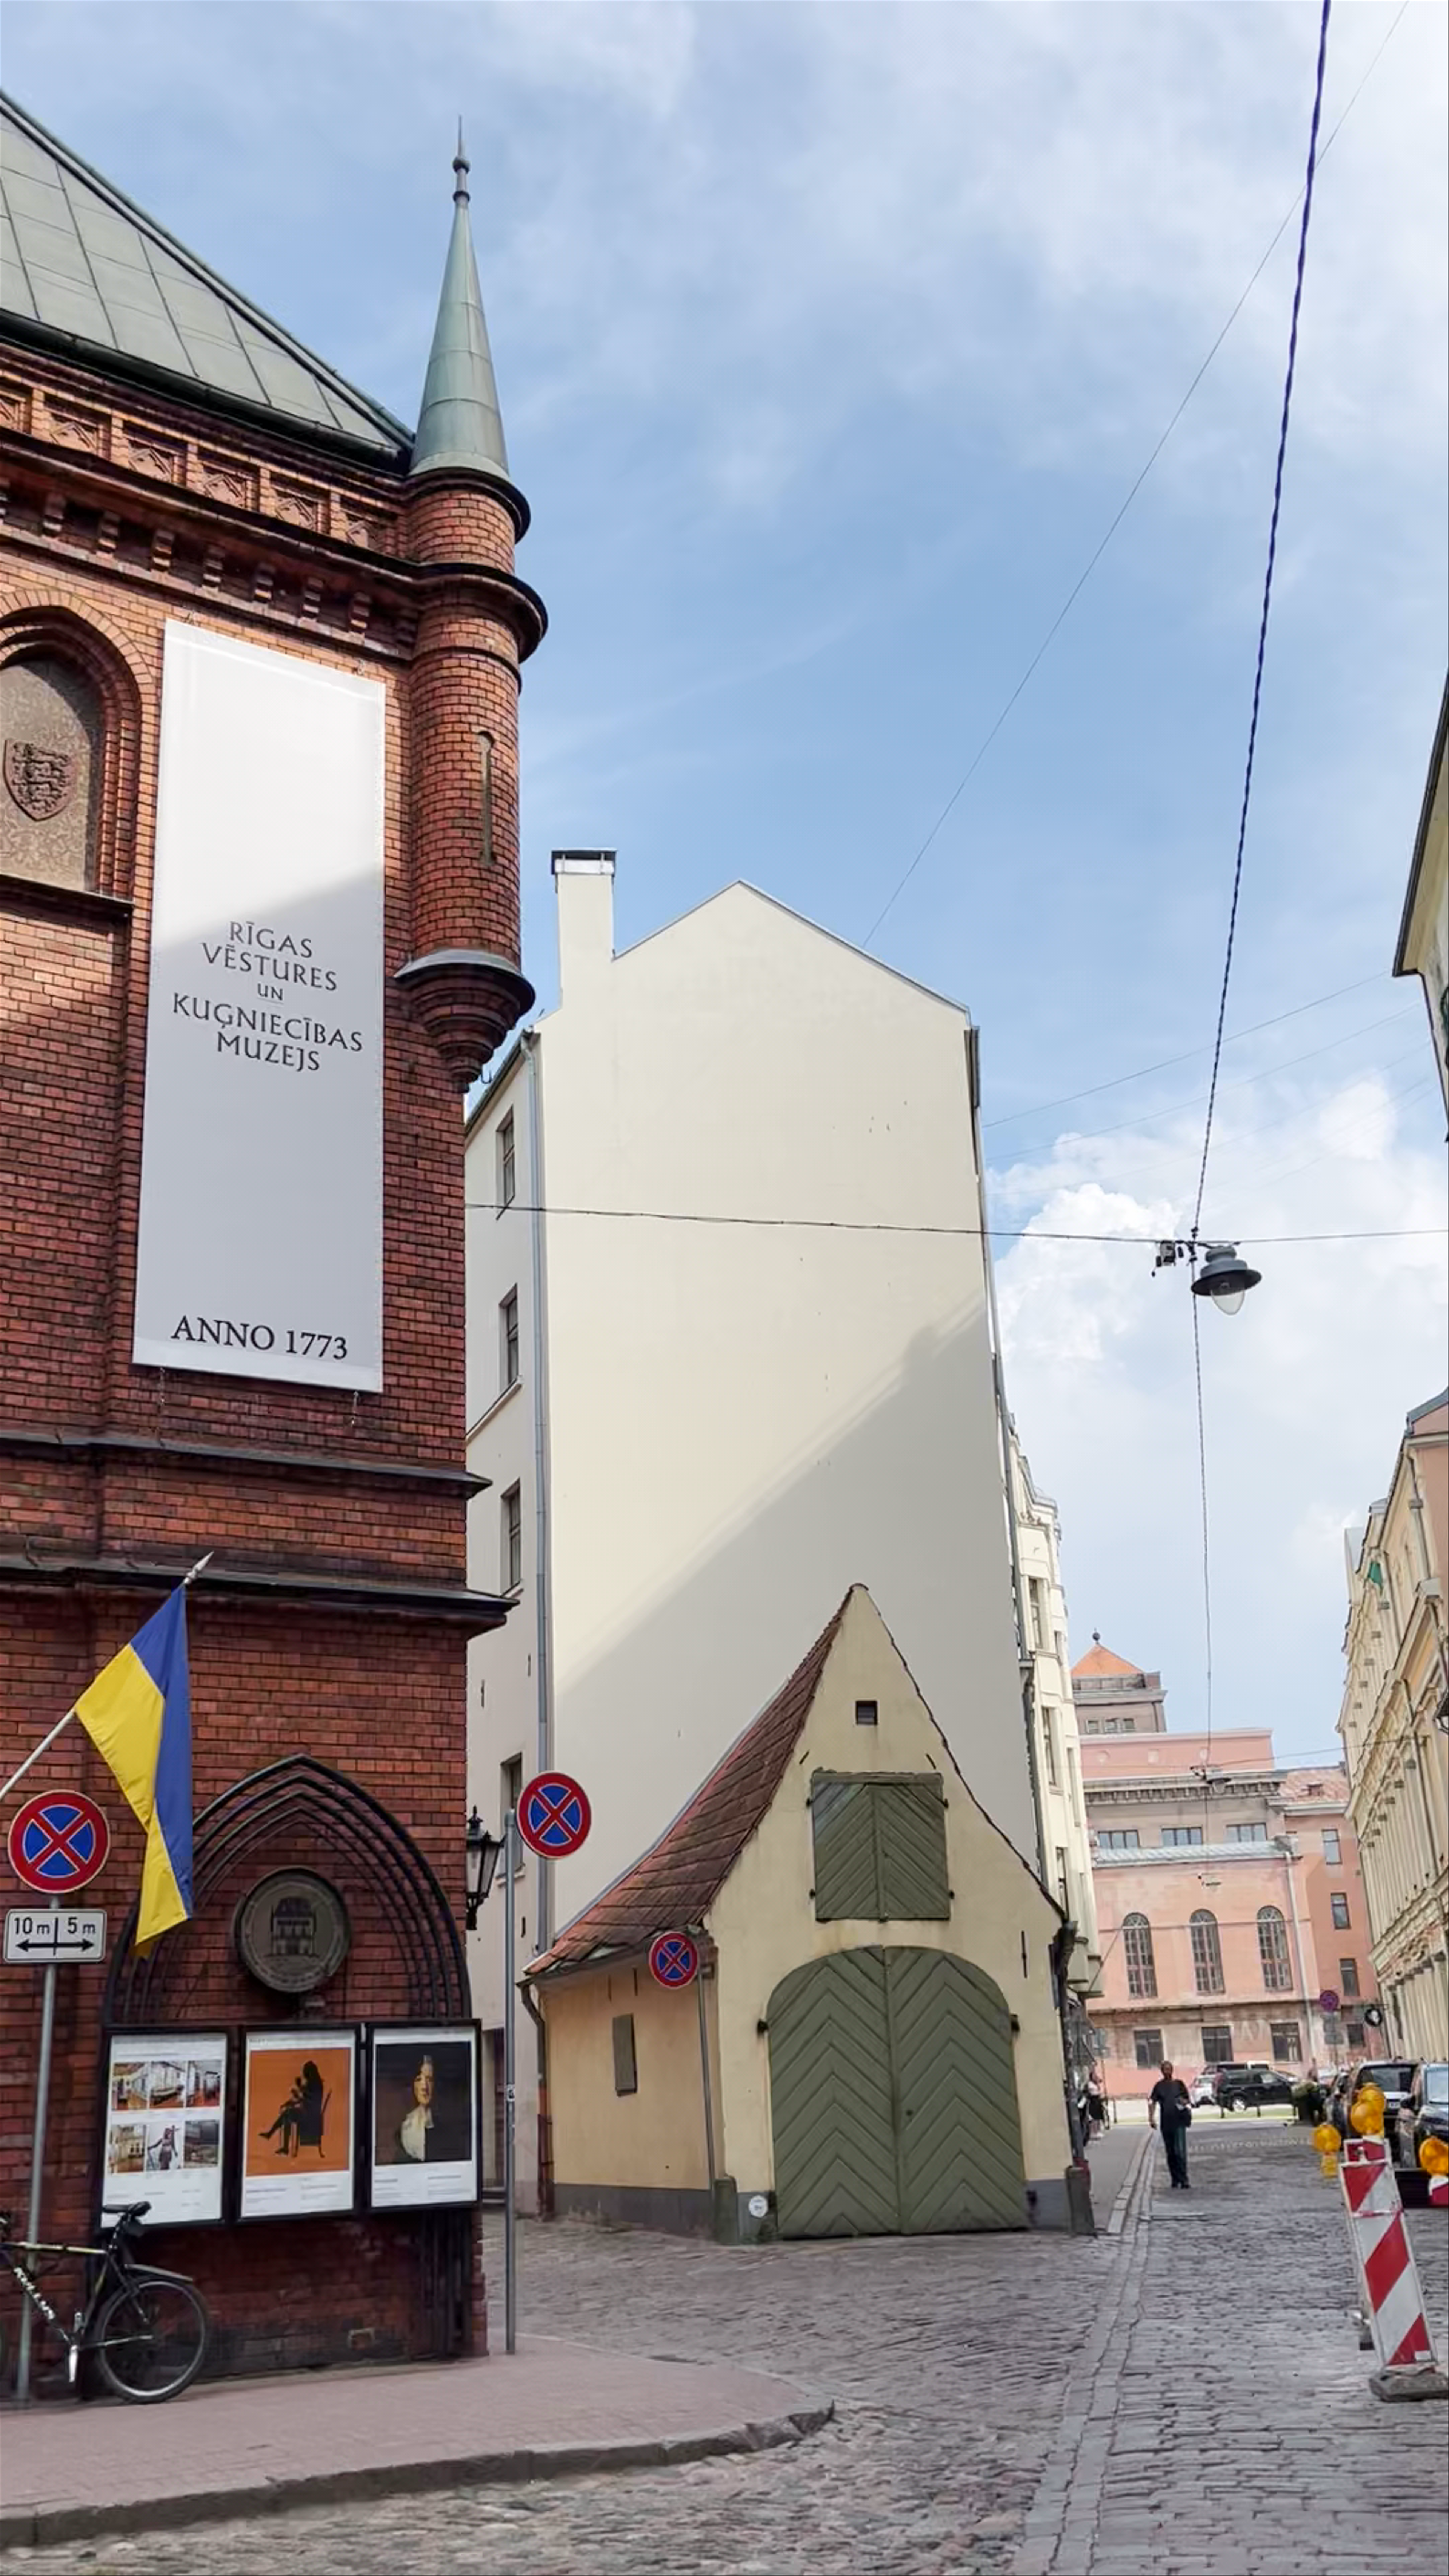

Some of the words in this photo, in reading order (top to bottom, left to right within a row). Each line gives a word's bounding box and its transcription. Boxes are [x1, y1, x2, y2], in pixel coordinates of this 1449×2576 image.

[229, 920, 313, 958] RĪGAS
[201, 942, 337, 992] VĒSTURES
[257, 983, 283, 1001] UN
[173, 992, 363, 1052] KUĢNIECĪBAS
[217, 1031, 320, 1072] MUZEJS
[171, 1315, 275, 1351] ANNO
[286, 1330, 348, 1361] 1773
[14, 1916, 33, 1935] 10
[37, 1924, 50, 1935] m
[67, 1916, 78, 1935] 5
[82, 1923, 96, 1935] m
